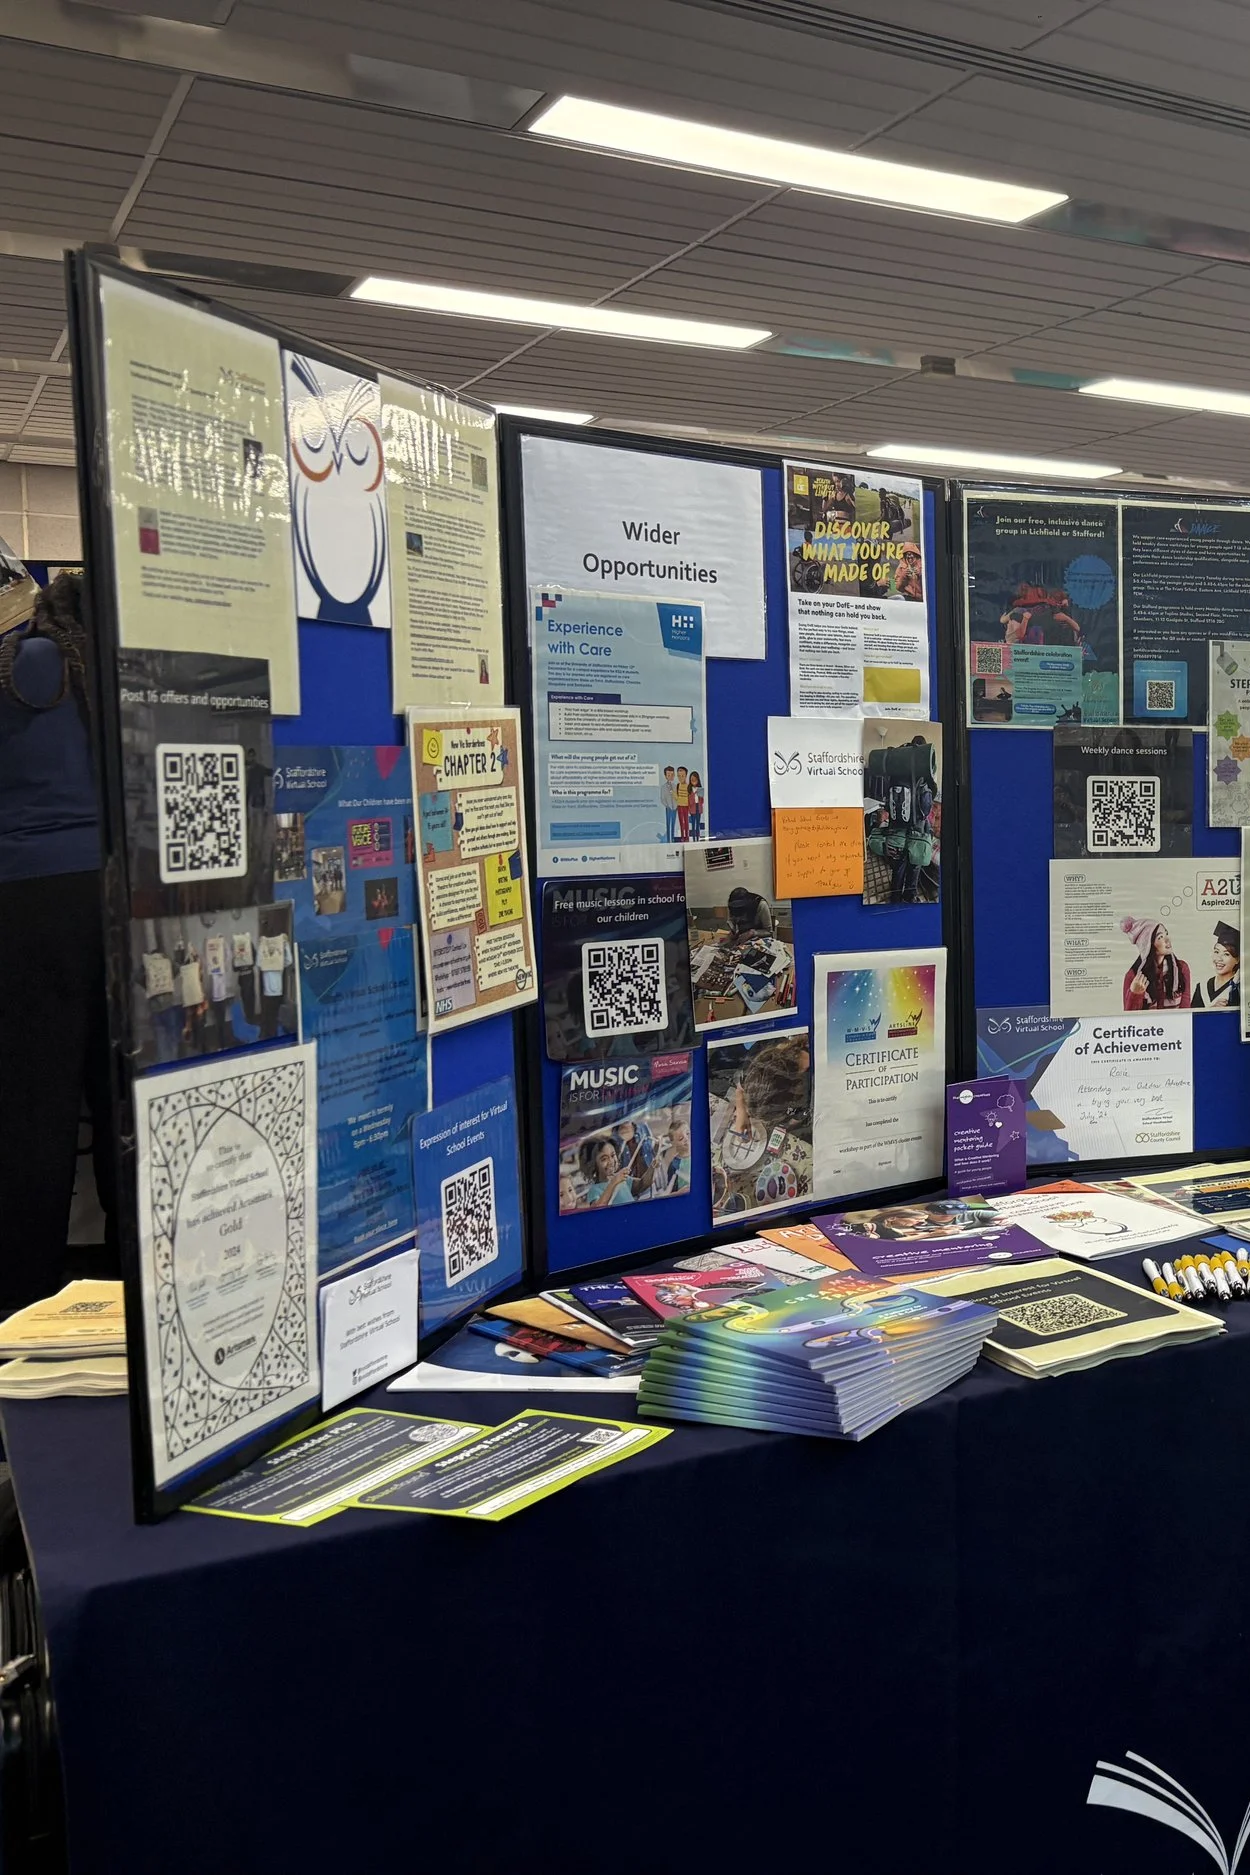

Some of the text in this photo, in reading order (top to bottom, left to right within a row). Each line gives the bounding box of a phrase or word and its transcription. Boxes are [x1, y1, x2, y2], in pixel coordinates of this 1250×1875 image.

[996, 515, 1011, 525] Join
[1028, 516, 1046, 526] free,
[1048, 518, 1080, 526] inclusive
[622, 521, 680, 545] Wider
[815, 521, 890, 539] DISCOVER
[1029, 528, 1060, 536] Lichfield
[1073, 530, 1105, 538] Stafford!
[803, 542, 904, 560] WHAT YOU'RE
[583, 553, 718, 583] Opportunities
[824, 563, 890, 582] MADE OF
[811, 609, 834, 618] nothing
[548, 619, 623, 636] Experience
[548, 641, 612, 656] with Care
[121, 688, 269, 709] Post 16 offers and opportunities
[808, 752, 864, 763] Staffordshire
[1081, 746, 1167, 757] Weekly dance sessions
[444, 752, 496, 777] CHAPTER 2
[807, 766, 863, 775] Virtual Schoo
[554, 894, 685, 910] Free music lessons in school fo
[1201, 899, 1240, 907] Aspire2Un
[597, 912, 649, 923] our children
[436, 1000, 452, 1013] NHS
[1015, 1025, 1039, 1033] Virtual
[1093, 1025, 1164, 1039] Certificate
[1075, 1040, 1182, 1055] of Achievement
[845, 1047, 919, 1067] CERTIFICATE
[878, 1065, 888, 1073] OF
[1110, 1067, 1128, 1077] Rosie
[570, 1065, 639, 1090] MUSIC
[846, 1071, 919, 1090] PARTICIPATION
[580, 1090, 599, 1101] FOR
[1078, 1085, 1111, 1095] Attending
[420, 1101, 508, 1149] Expression of interest for Virtual
[873, 1118, 892, 1127] completed
[954, 1128, 980, 1136] creative
[954, 1135, 983, 1144] mentoring
[447, 1130, 485, 1156] School Events
[954, 1142, 993, 1152] pocket guide
[219, 1218, 244, 1237] Gold
[872, 1242, 994, 1260] creative mentoring
[829, 1275, 853, 1286] MY
[1052, 1275, 1082, 1287] Virtual
[787, 1278, 870, 1304] CREATIVE
[821, 1283, 884, 1301] TRACK
[267, 1421, 357, 1465] Stepladder Plus
[434, 1421, 528, 1470] Stepping Forward
